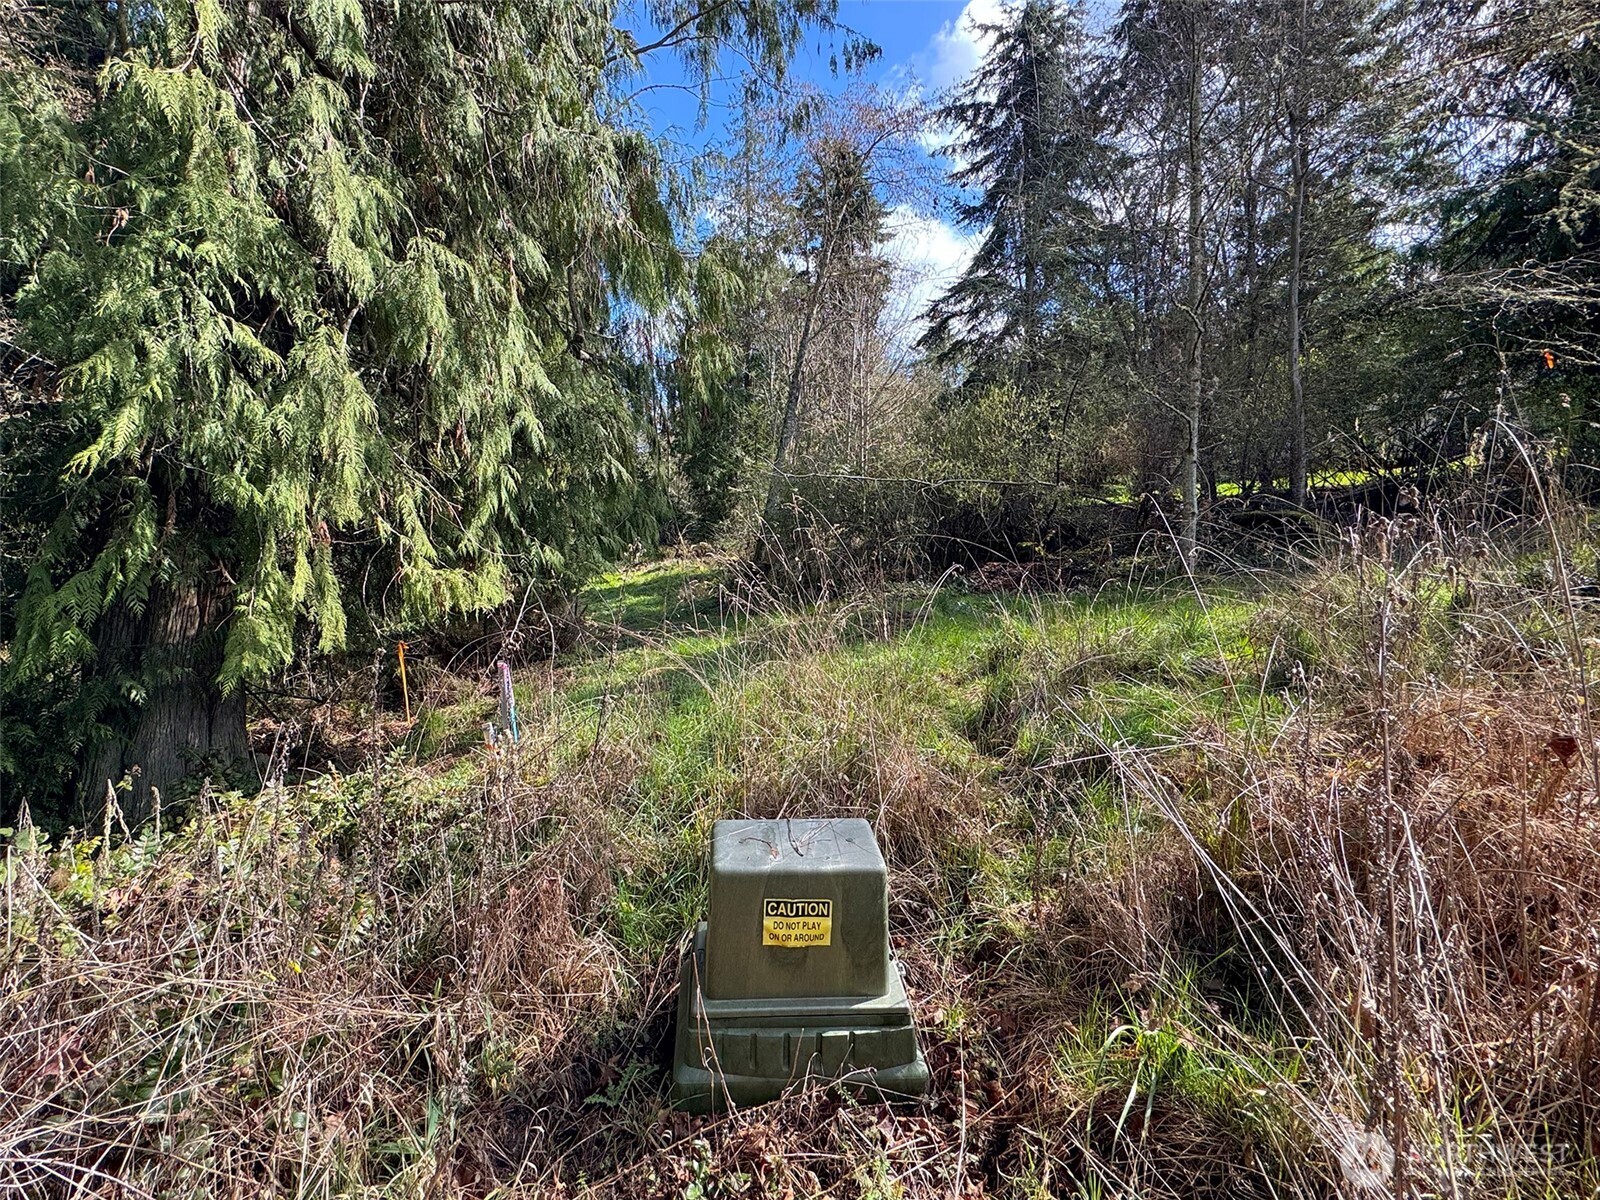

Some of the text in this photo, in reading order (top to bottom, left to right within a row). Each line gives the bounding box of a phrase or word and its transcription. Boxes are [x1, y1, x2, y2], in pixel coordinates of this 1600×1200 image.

[767, 902, 828, 916] CAUTION
[773, 921, 822, 930] DO NOT PLAY
[768, 932, 825, 942] ON OR AROUND
